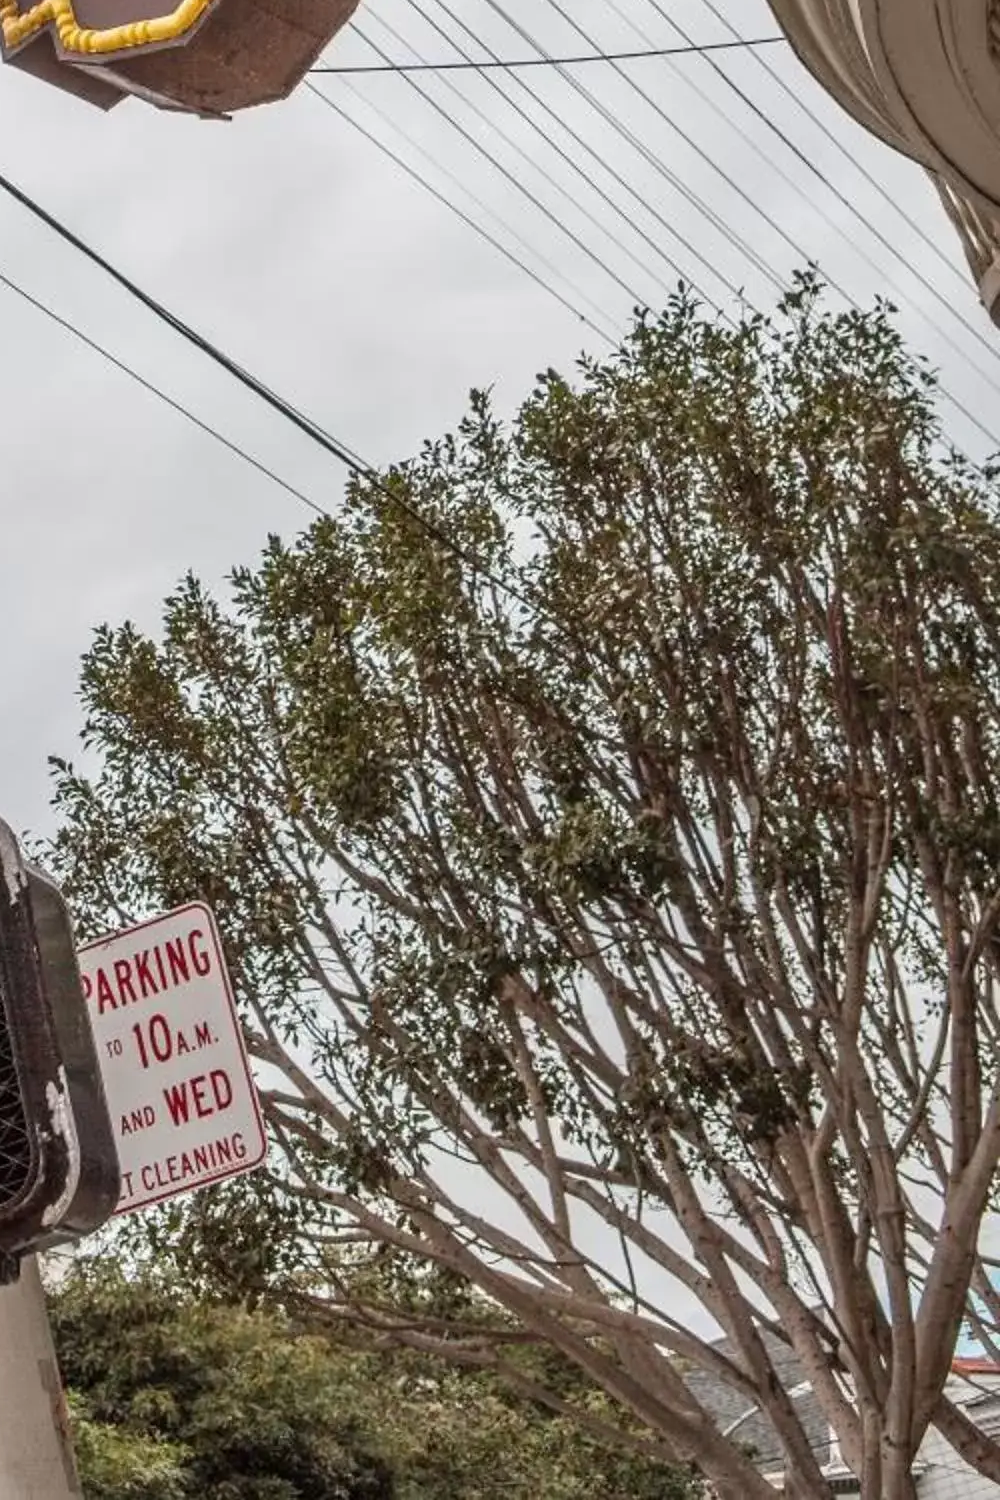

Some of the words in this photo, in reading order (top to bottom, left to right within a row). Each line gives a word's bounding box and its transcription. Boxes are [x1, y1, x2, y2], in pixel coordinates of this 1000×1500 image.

[106, 1038, 123, 1058] TO
[121, 1106, 155, 1136] AND
[163, 1069, 232, 1127] WED
[141, 1132, 246, 1191] CLEANING
